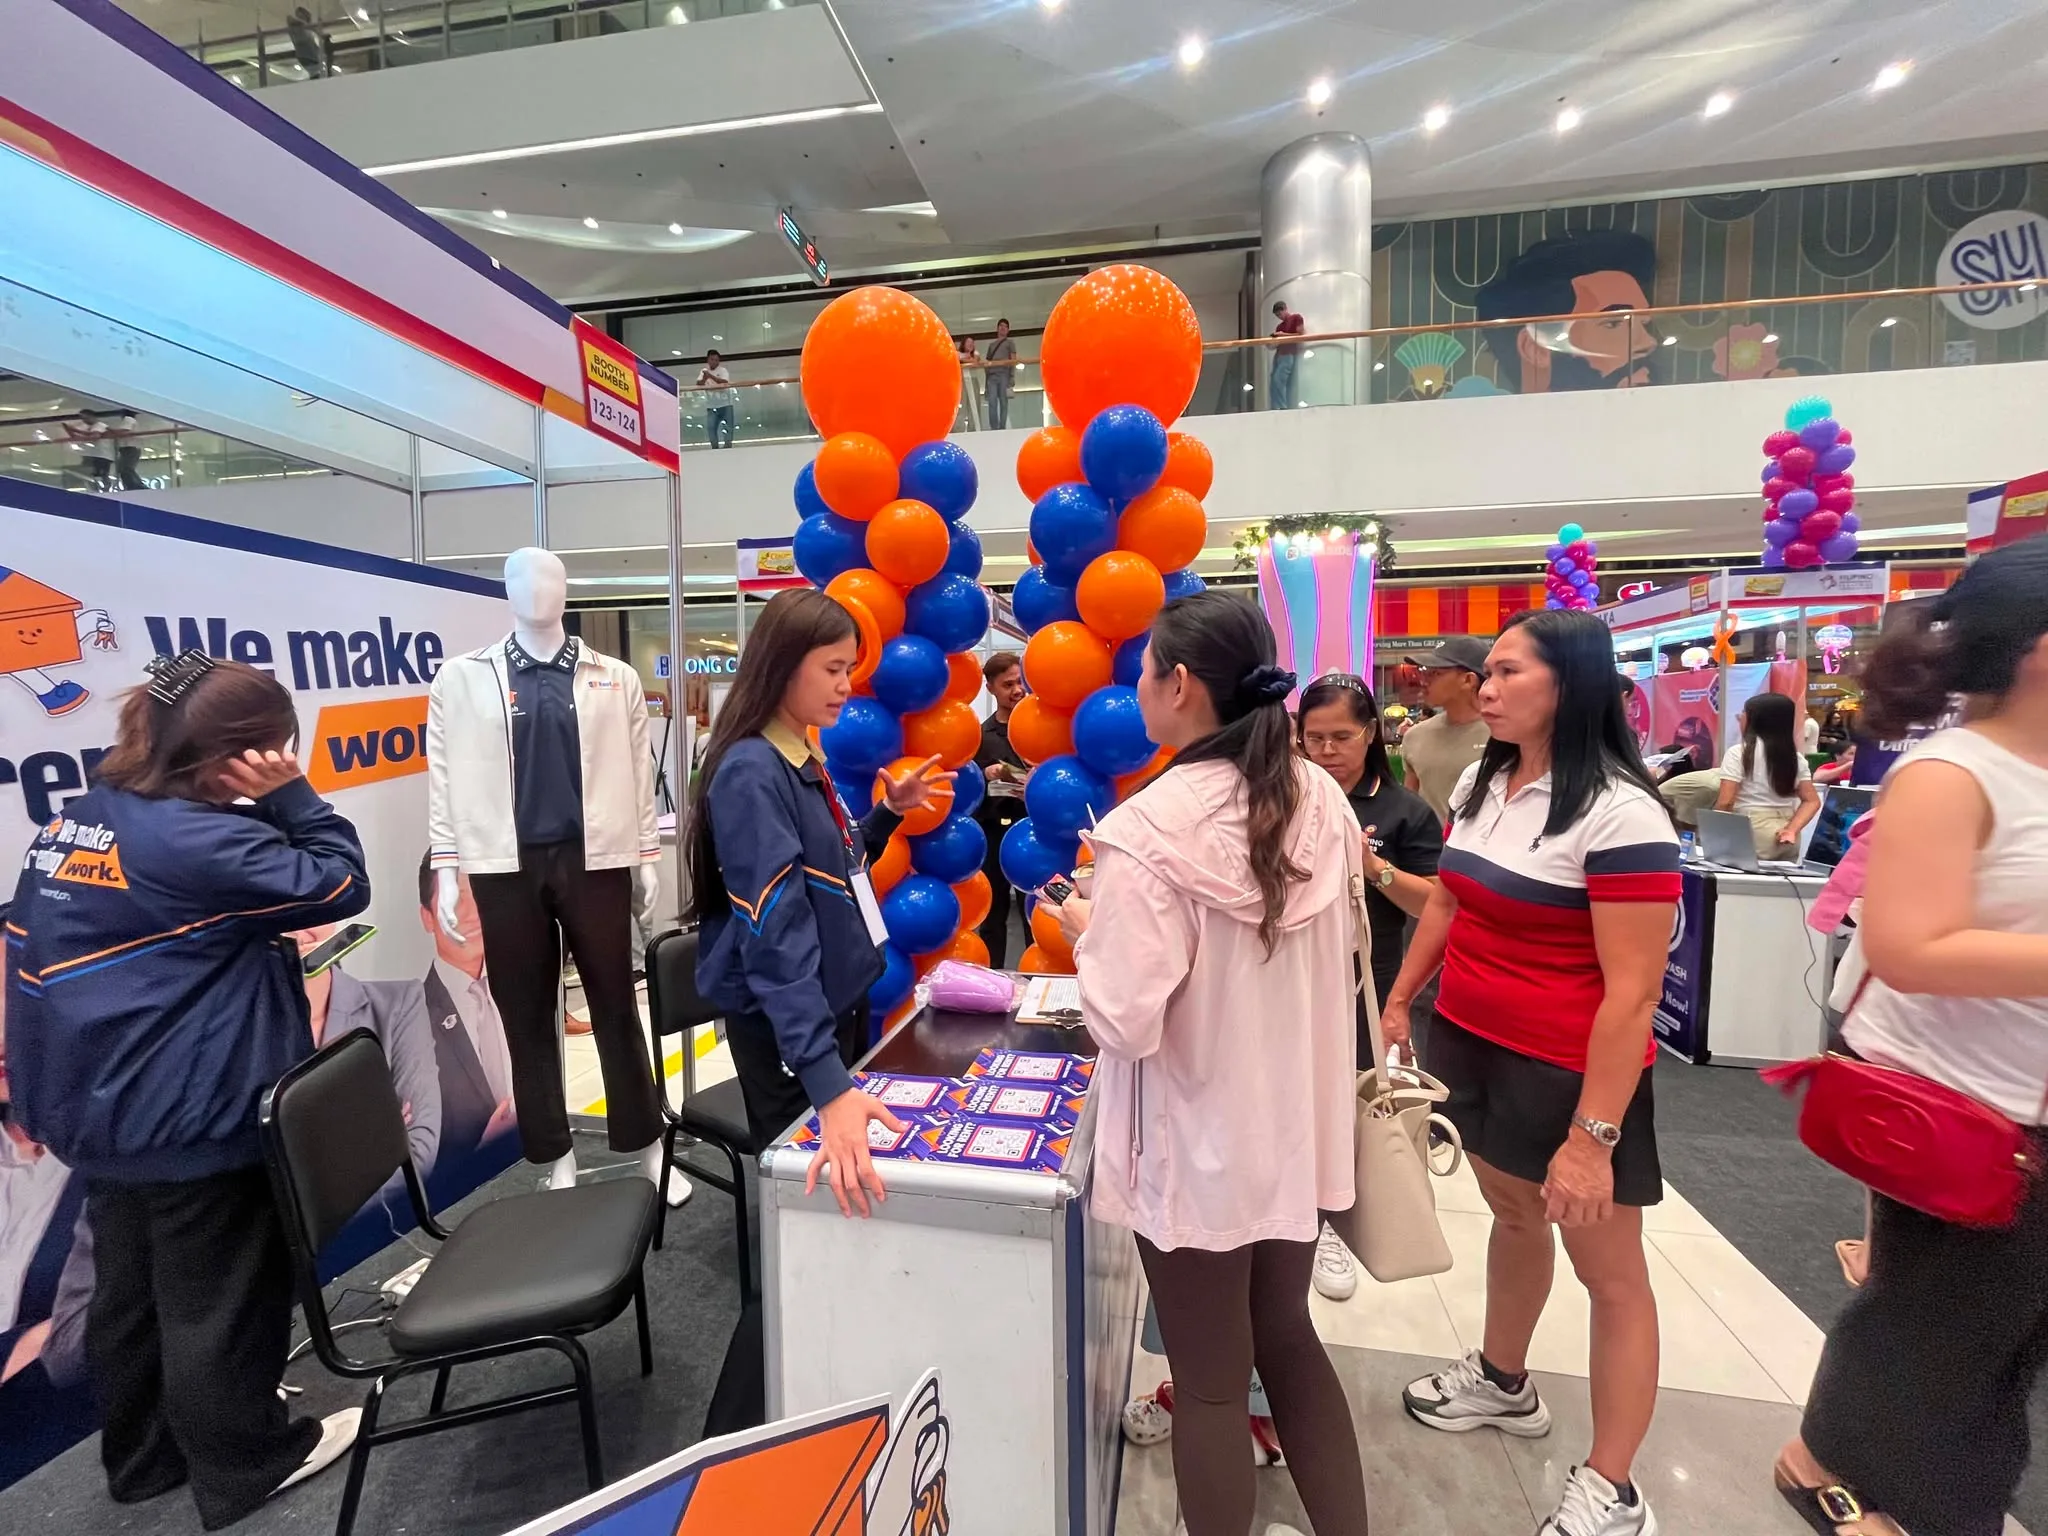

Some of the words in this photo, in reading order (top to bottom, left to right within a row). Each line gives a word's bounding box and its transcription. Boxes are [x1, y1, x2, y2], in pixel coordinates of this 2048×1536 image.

[589, 363, 631, 393] NUMBER
[592, 353, 627, 379] BOOTH
[592, 397, 637, 433] 123-124
[144, 616, 277, 675] We
[288, 616, 445, 691] make
[684, 657, 722, 674] ONG
[326, 722, 429, 773] wor
[55, 818, 78, 843] We
[74, 822, 116, 851] make
[1665, 990, 1689, 1015] Now!
[937, 1122, 964, 1154] LOOKING
[946, 1141, 964, 1158] FOR
[960, 1121, 977, 1144] RENT?
